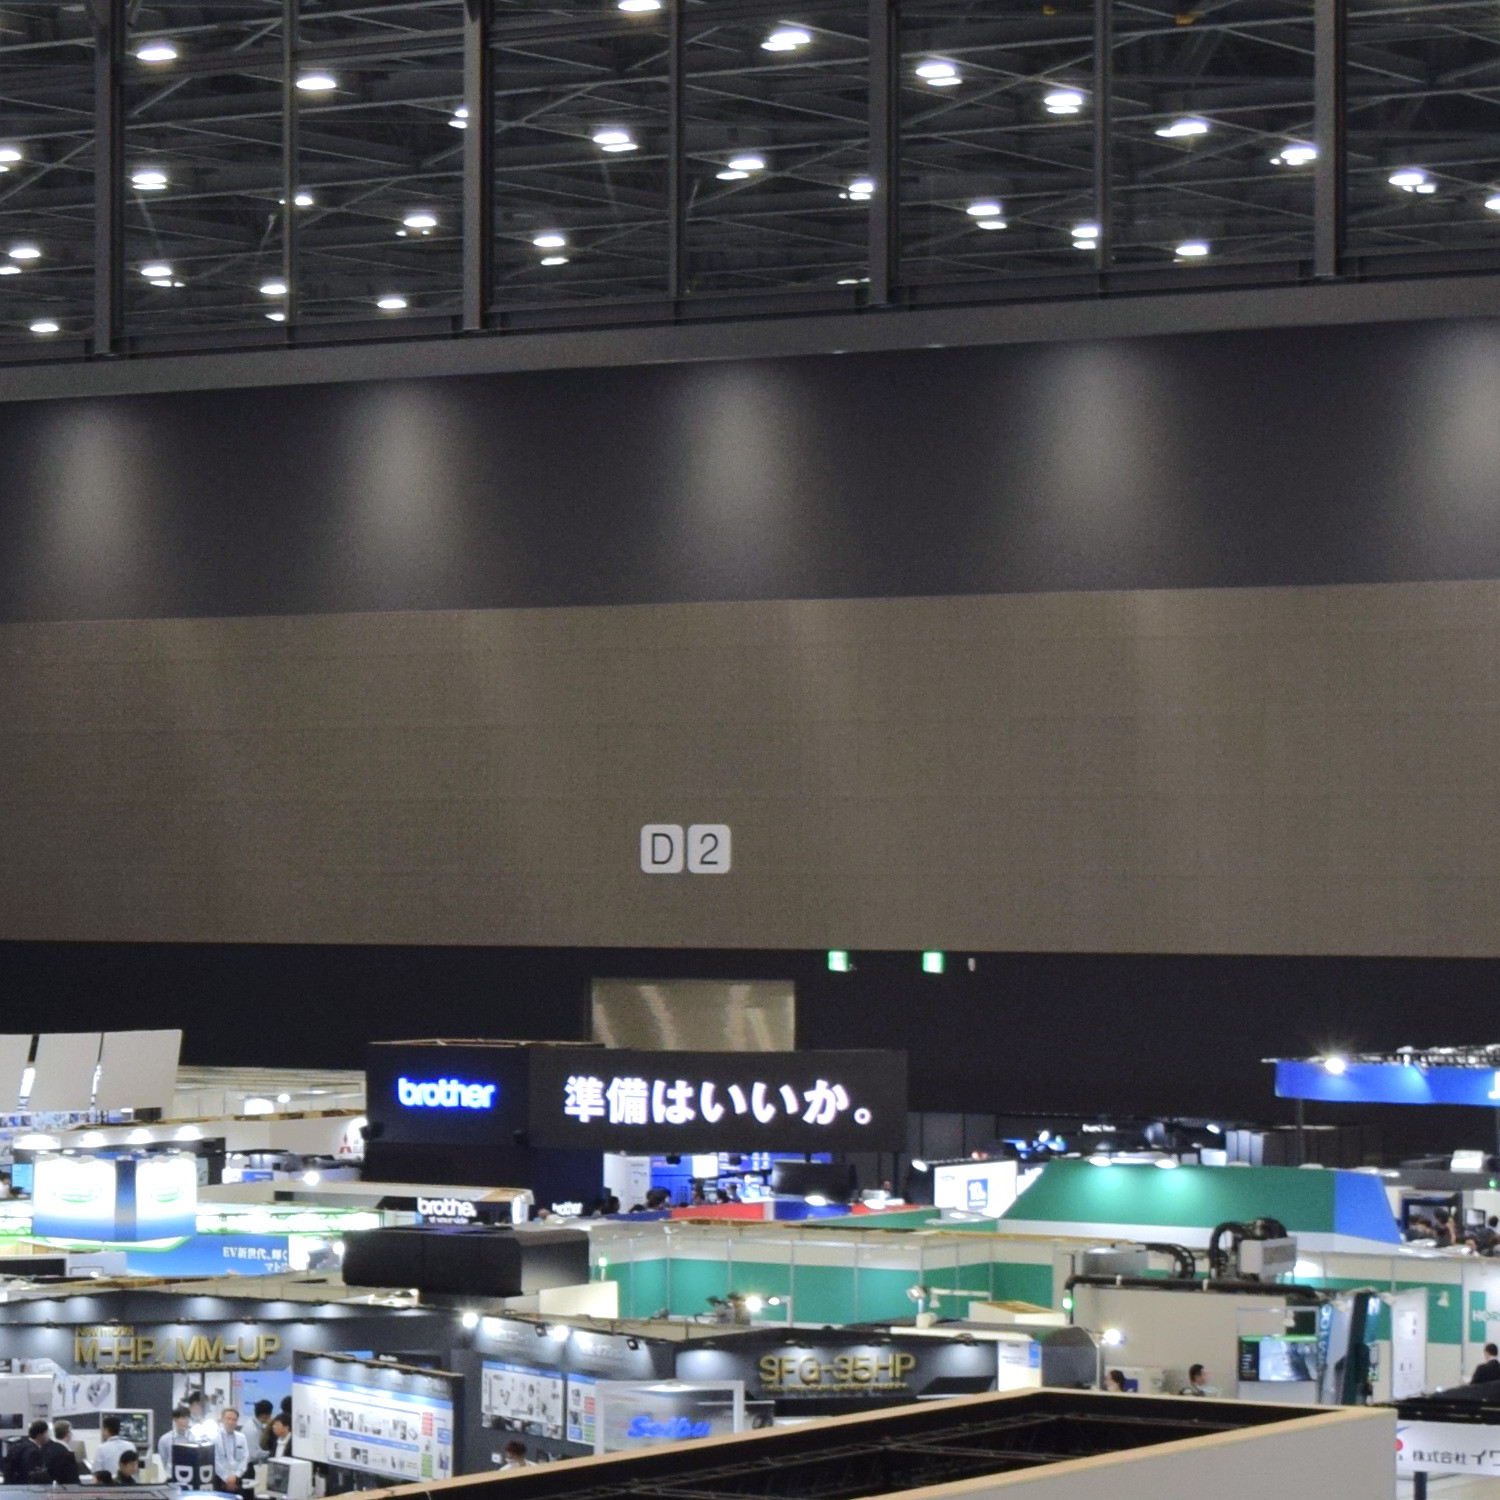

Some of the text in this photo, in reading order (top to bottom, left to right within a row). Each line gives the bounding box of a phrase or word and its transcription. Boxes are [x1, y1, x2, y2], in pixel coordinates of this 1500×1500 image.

[397, 1077, 496, 1108] brother
[563, 1074, 873, 1126] 準備はいいか。
